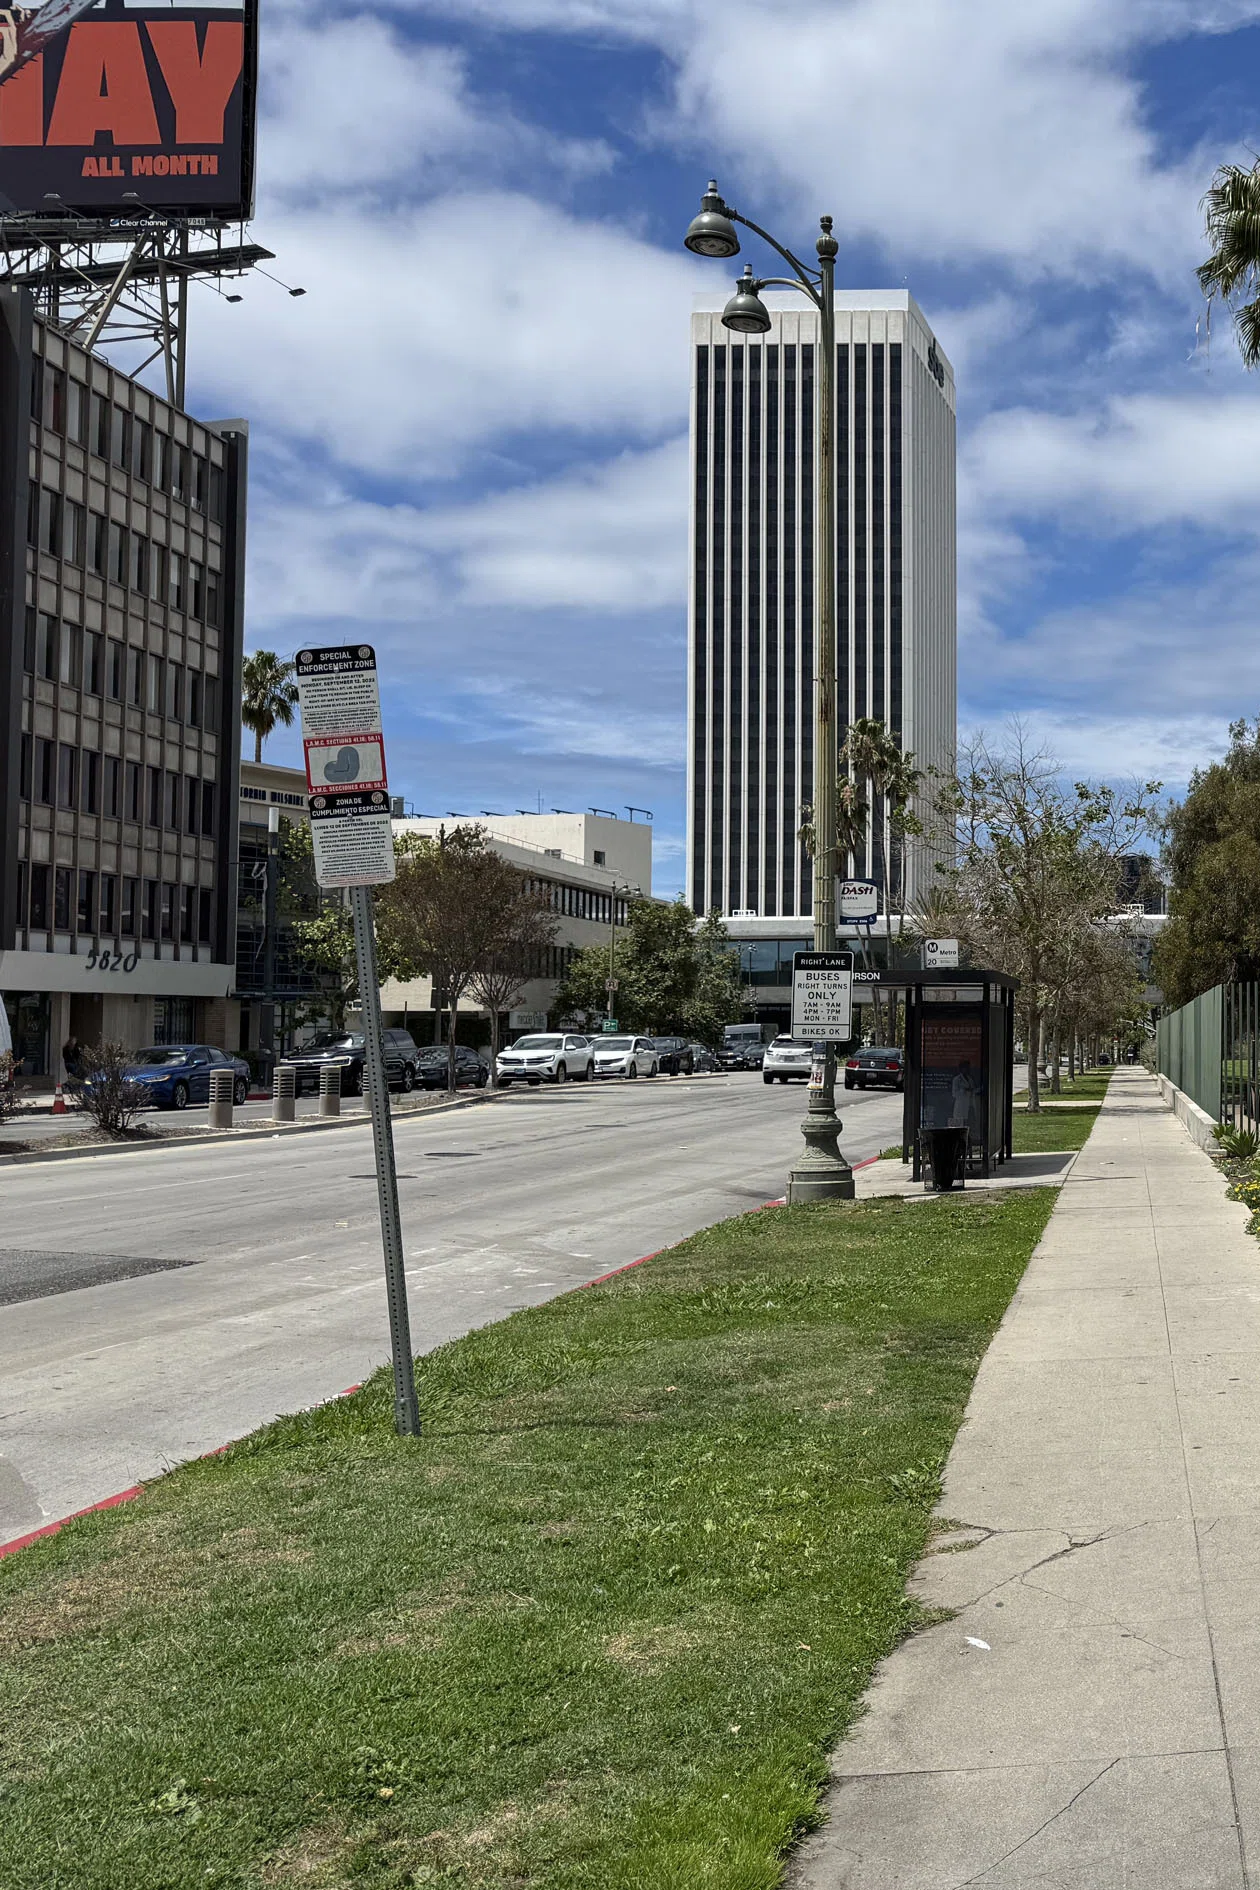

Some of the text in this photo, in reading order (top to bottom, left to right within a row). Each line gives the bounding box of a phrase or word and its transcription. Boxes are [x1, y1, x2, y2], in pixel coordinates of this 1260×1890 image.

[81, 155, 218, 176] ALL MONTH
[320, 651, 352, 660] SPECIAL
[299, 660, 374, 673] ENFORCEMENT ZONE
[312, 804, 388, 817] CUMPLIMIENTO ESPECIAL
[841, 886, 874, 895] DASH
[85, 949, 138, 973] 5820
[852, 972, 880, 980] RSON
